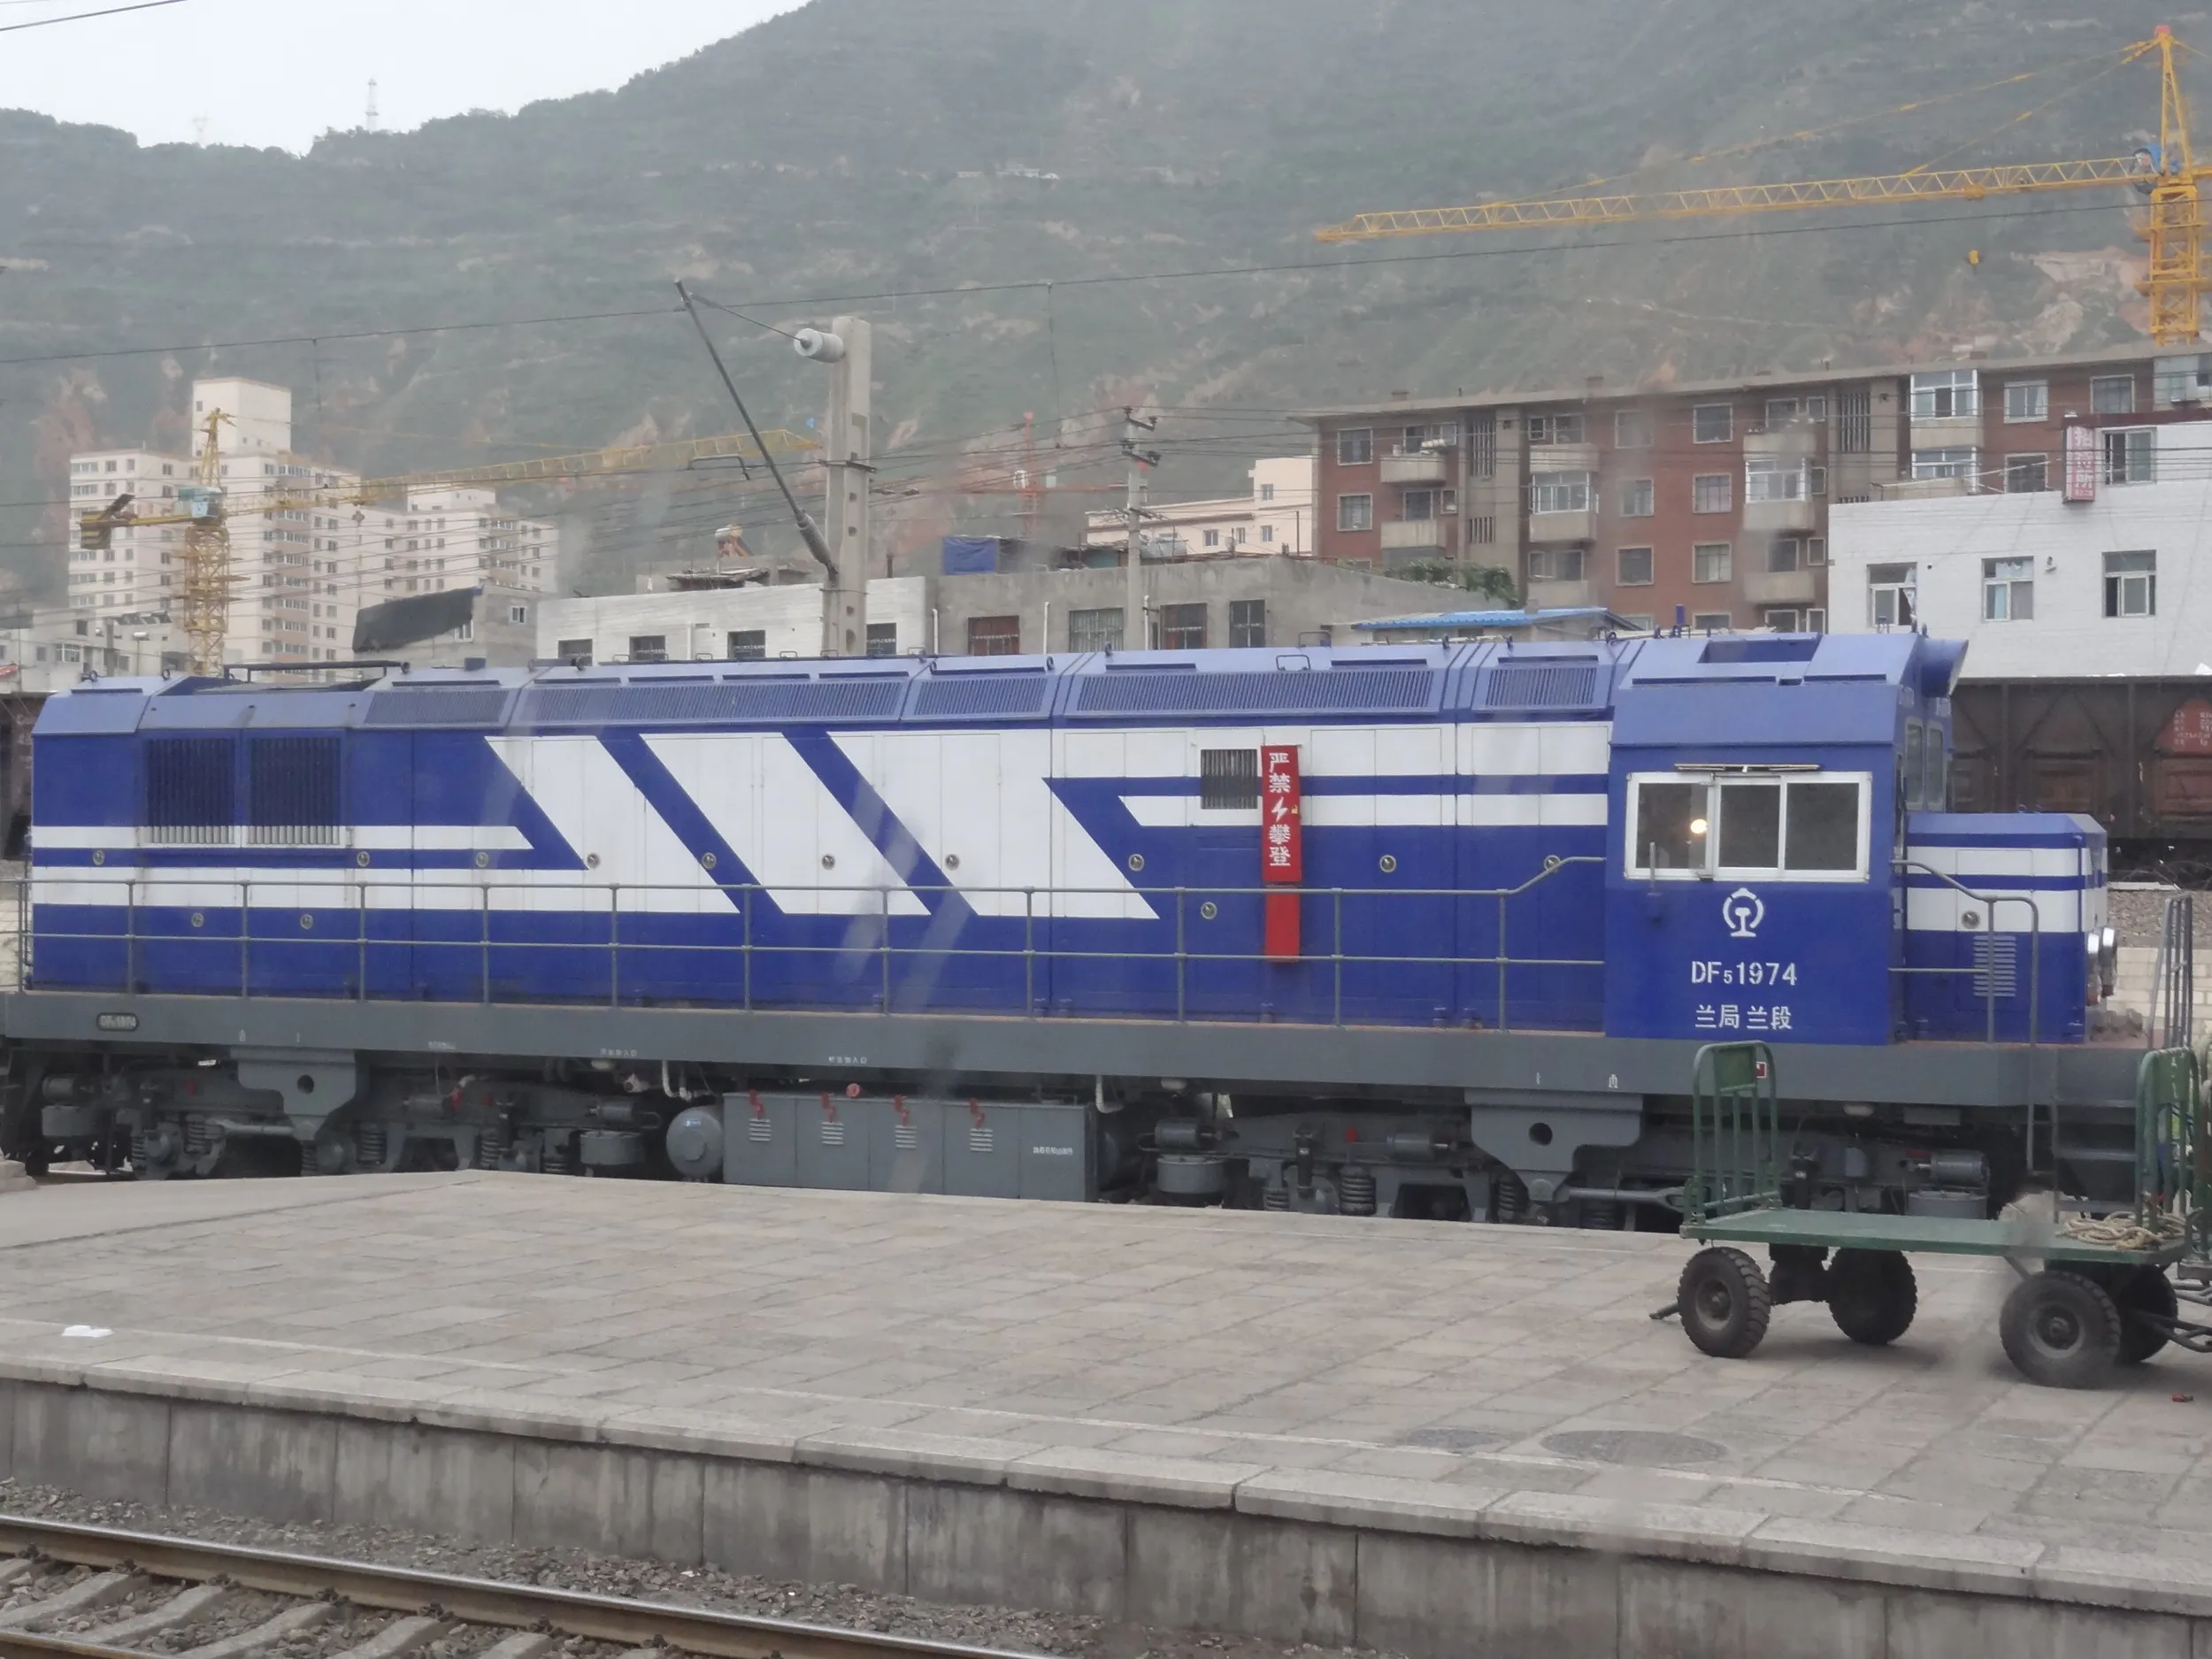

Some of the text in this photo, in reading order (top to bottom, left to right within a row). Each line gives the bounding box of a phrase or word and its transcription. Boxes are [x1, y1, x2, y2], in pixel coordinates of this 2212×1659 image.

[1269, 752, 1291, 866] 严禁攀登
[1694, 1004, 1793, 1030] 兰局 兰段
